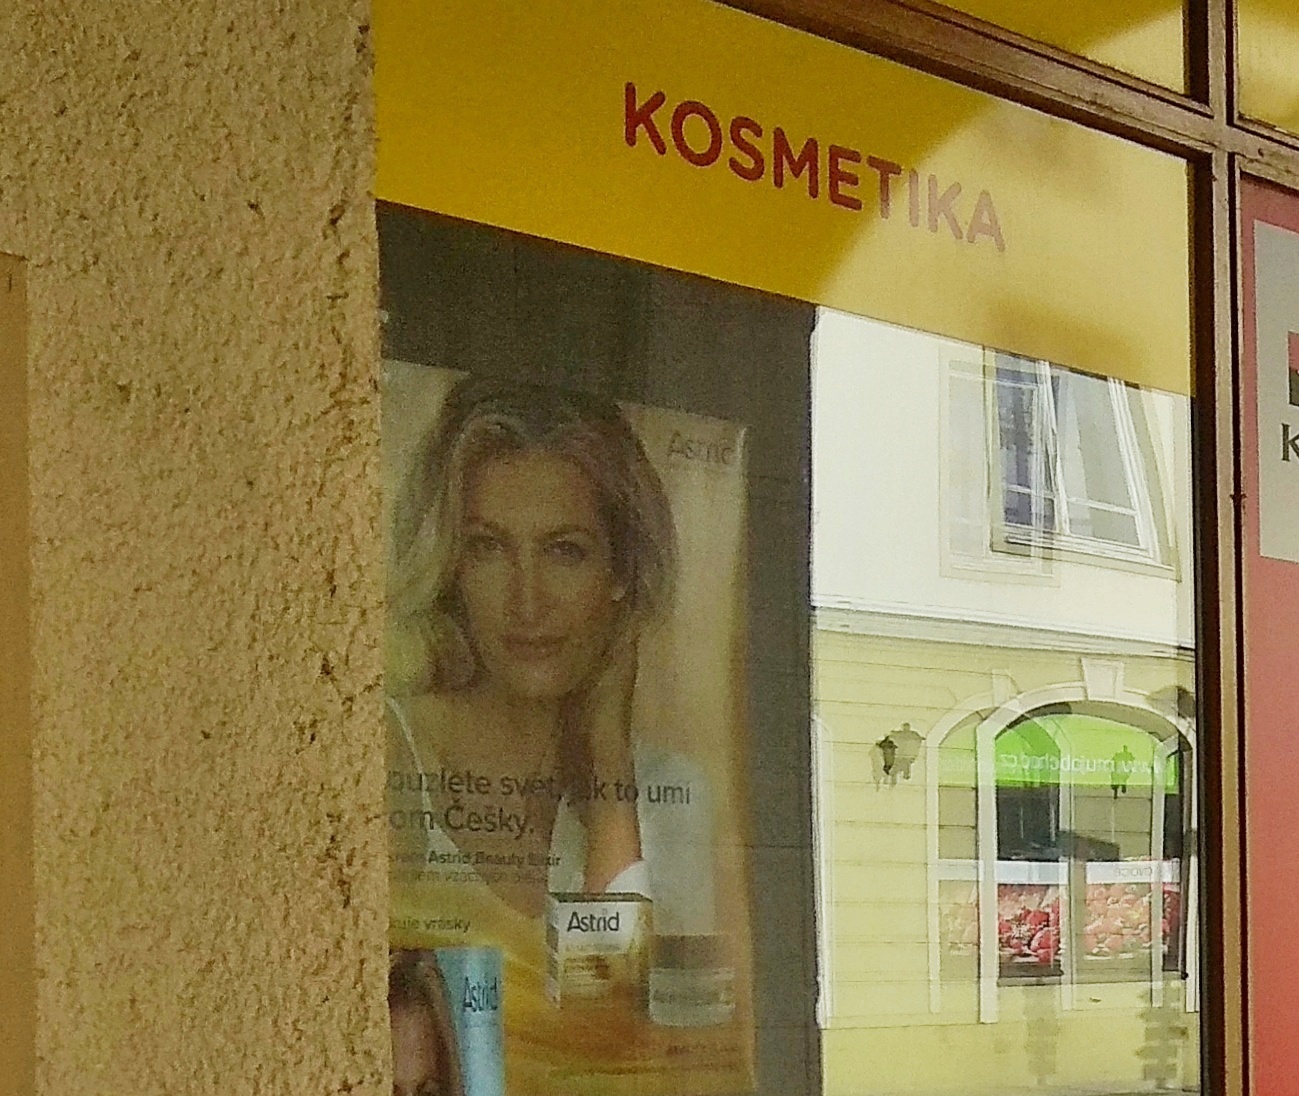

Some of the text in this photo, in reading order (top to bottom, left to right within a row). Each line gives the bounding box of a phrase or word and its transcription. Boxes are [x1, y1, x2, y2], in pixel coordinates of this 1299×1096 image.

[623, 81, 1006, 253] KOSMETIKA
[614, 778, 639, 803] to
[567, 911, 620, 932] Astrid
[463, 976, 499, 1012] Astrid
